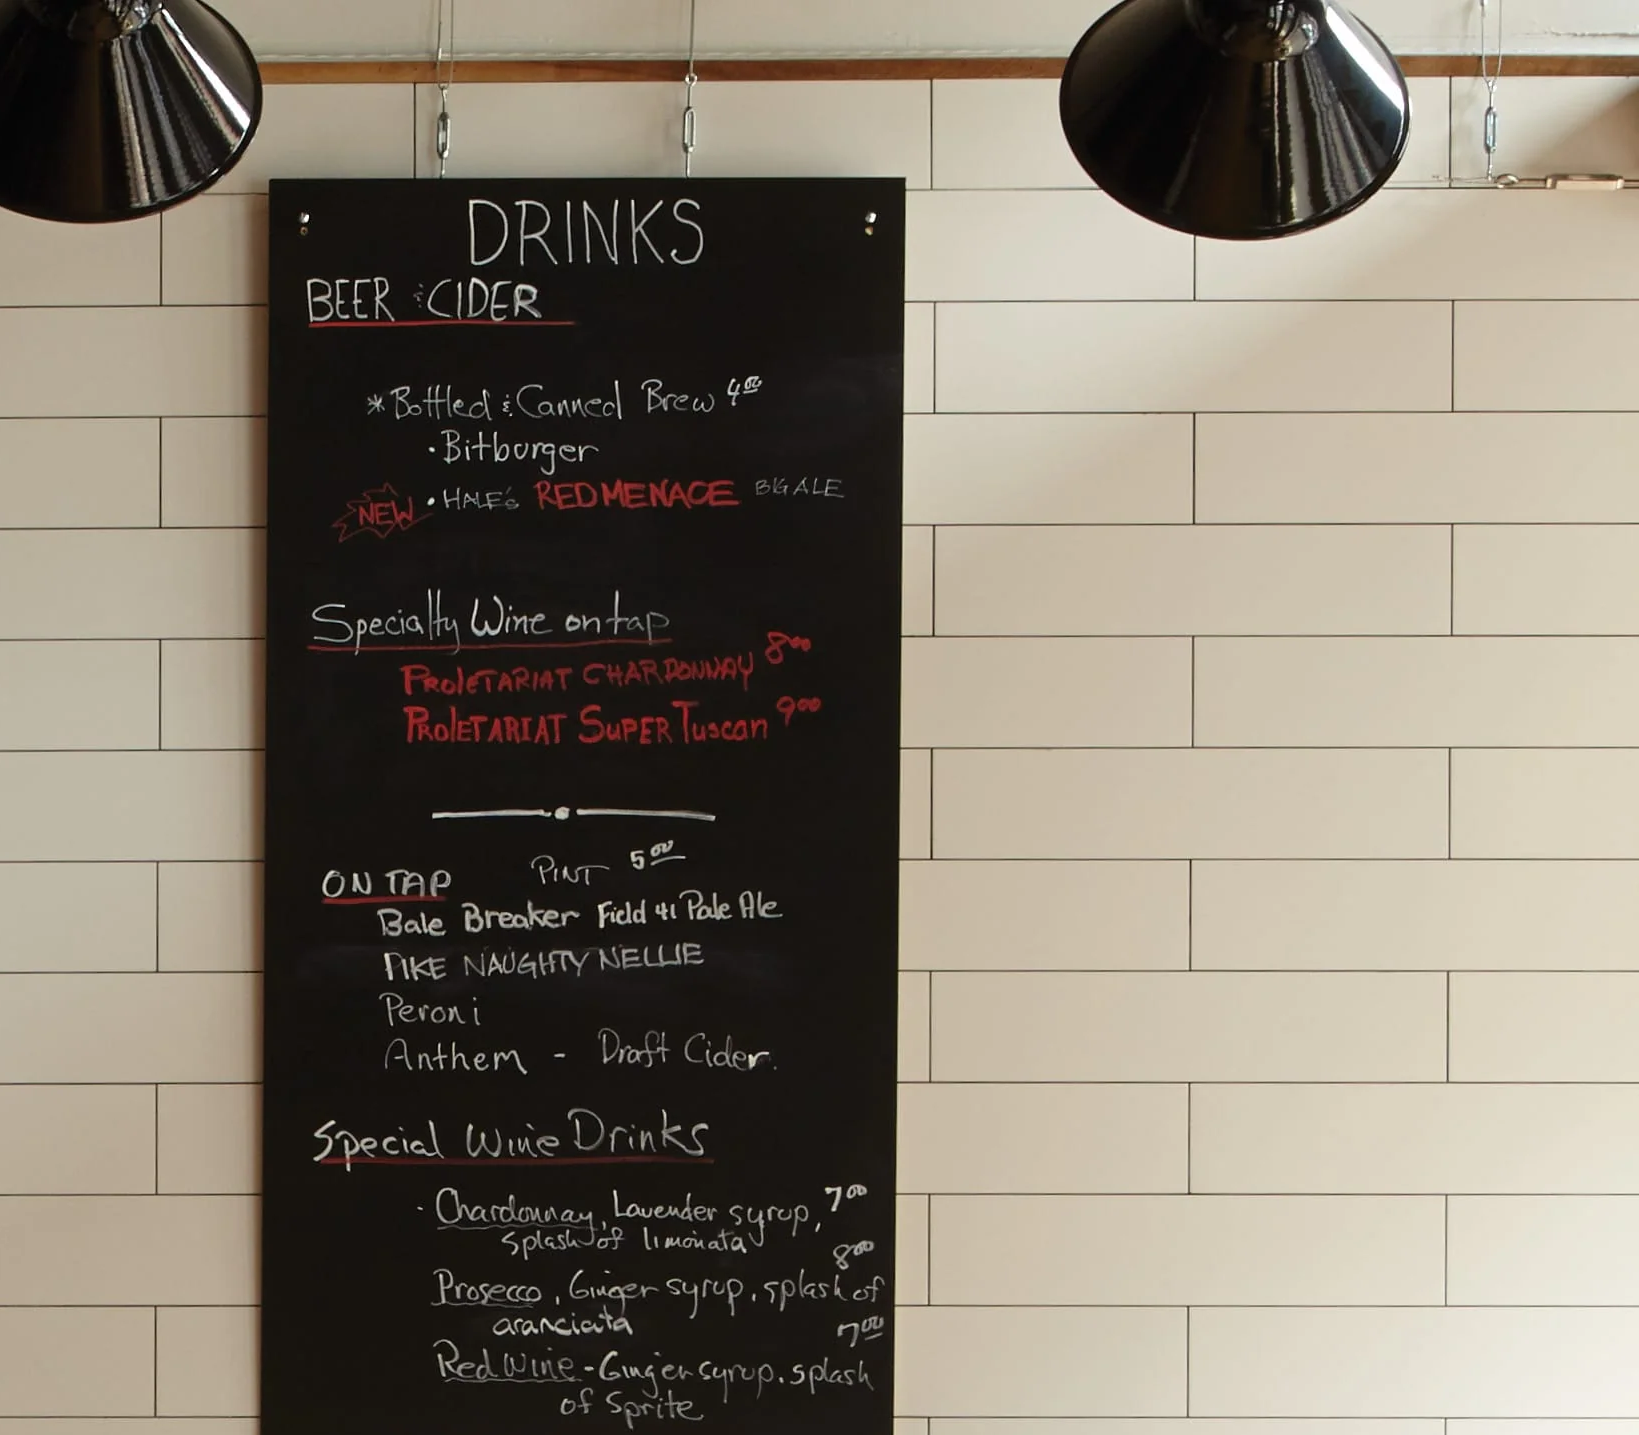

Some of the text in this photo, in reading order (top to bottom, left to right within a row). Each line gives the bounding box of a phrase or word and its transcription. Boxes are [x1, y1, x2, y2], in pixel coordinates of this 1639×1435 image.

[469, 198, 703, 266] DRINKS
[307, 277, 395, 319] BEER
[427, 277, 542, 318] CIDER
[390, 384, 492, 420] Bottled
[516, 380, 622, 420] Canned
[641, 379, 714, 413] Brew
[441, 429, 599, 475] Bitburger
[793, 477, 844, 497] ALE
[359, 493, 413, 531] NEW
[311, 588, 460, 656] Specialty
[471, 595, 552, 637] Wine
[606, 590, 669, 634] tap
[321, 870, 451, 897] ON TAP
[531, 855, 609, 885] PINT
[377, 890, 783, 936] Bale Breaker Field 41 Pale Ale
[384, 943, 704, 981] PIKE NAUGHTY NELLIE
[379, 993, 480, 1026] Peroni
[385, 1038, 527, 1075] Anthem
[598, 1028, 669, 1067] Draft
[313, 1108, 709, 1172] Special Wine Drinks
[613, 1189, 717, 1221] Lavender
[501, 1227, 747, 1260] splash of limonata
[569, 1269, 659, 1316] Ginger
[764, 1268, 847, 1312] splash
[853, 1276, 885, 1302] of
[492, 1306, 633, 1336] aranciata
[433, 1340, 501, 1379] Red
[790, 1357, 873, 1394] splash
[560, 1388, 704, 1429] of Sprite
